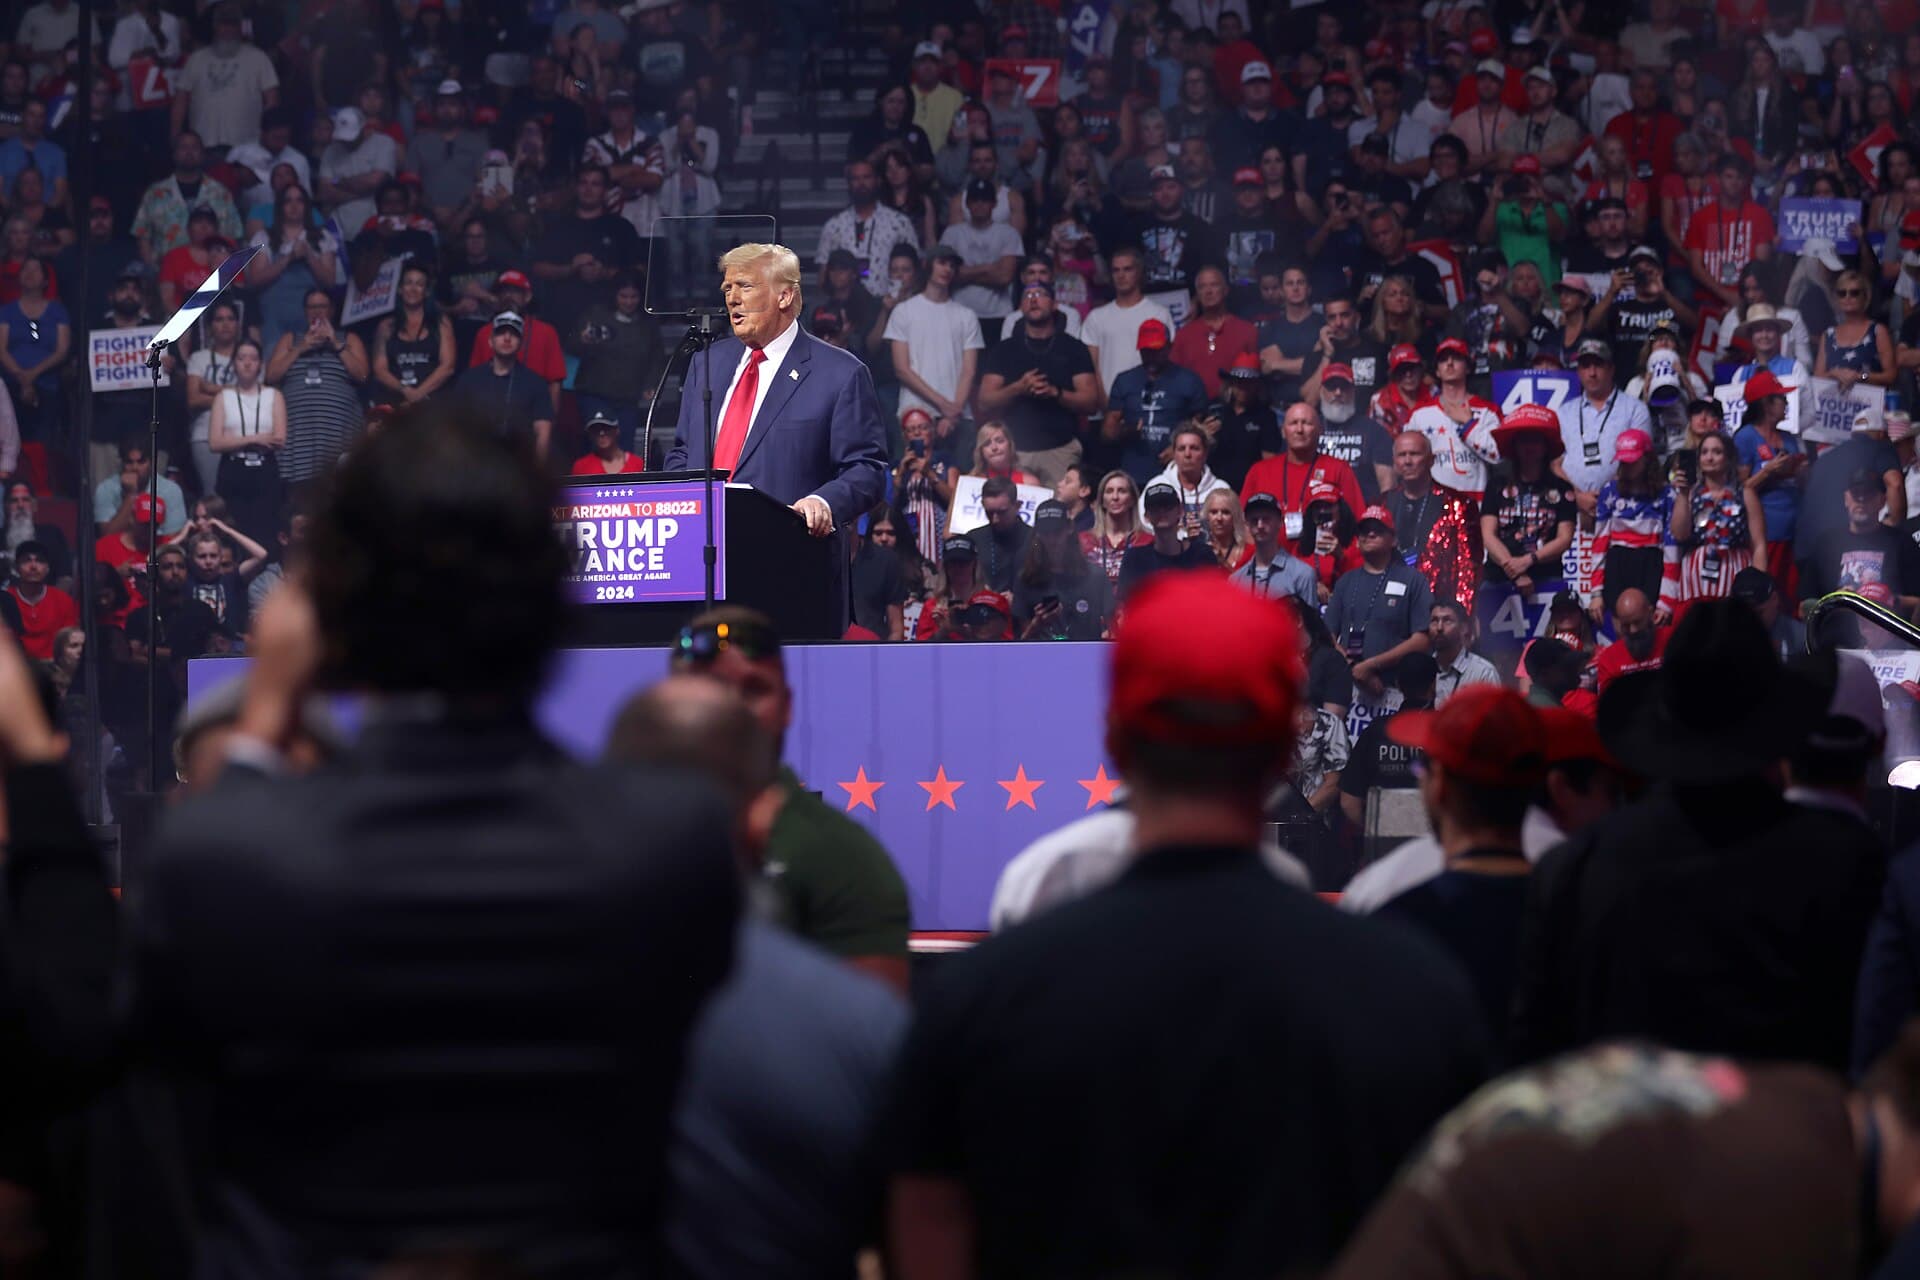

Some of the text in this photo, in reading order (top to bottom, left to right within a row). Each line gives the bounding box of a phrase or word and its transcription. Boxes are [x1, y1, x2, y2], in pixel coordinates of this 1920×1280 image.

[1784, 211, 1857, 227] TRUMP
[1791, 225, 1848, 241] VANCE
[95, 365, 148, 381] FIGHT
[1501, 377, 1571, 417] 47
[571, 503, 631, 519] ARIZONA
[634, 504, 652, 517] TO
[655, 501, 697, 515] 88022
[583, 574, 617, 582] AMERICA
[618, 573, 643, 581] GREAT
[596, 586, 636, 600] 2024
[1489, 593, 1555, 639] 47
[1379, 745, 1425, 761] POLIC
